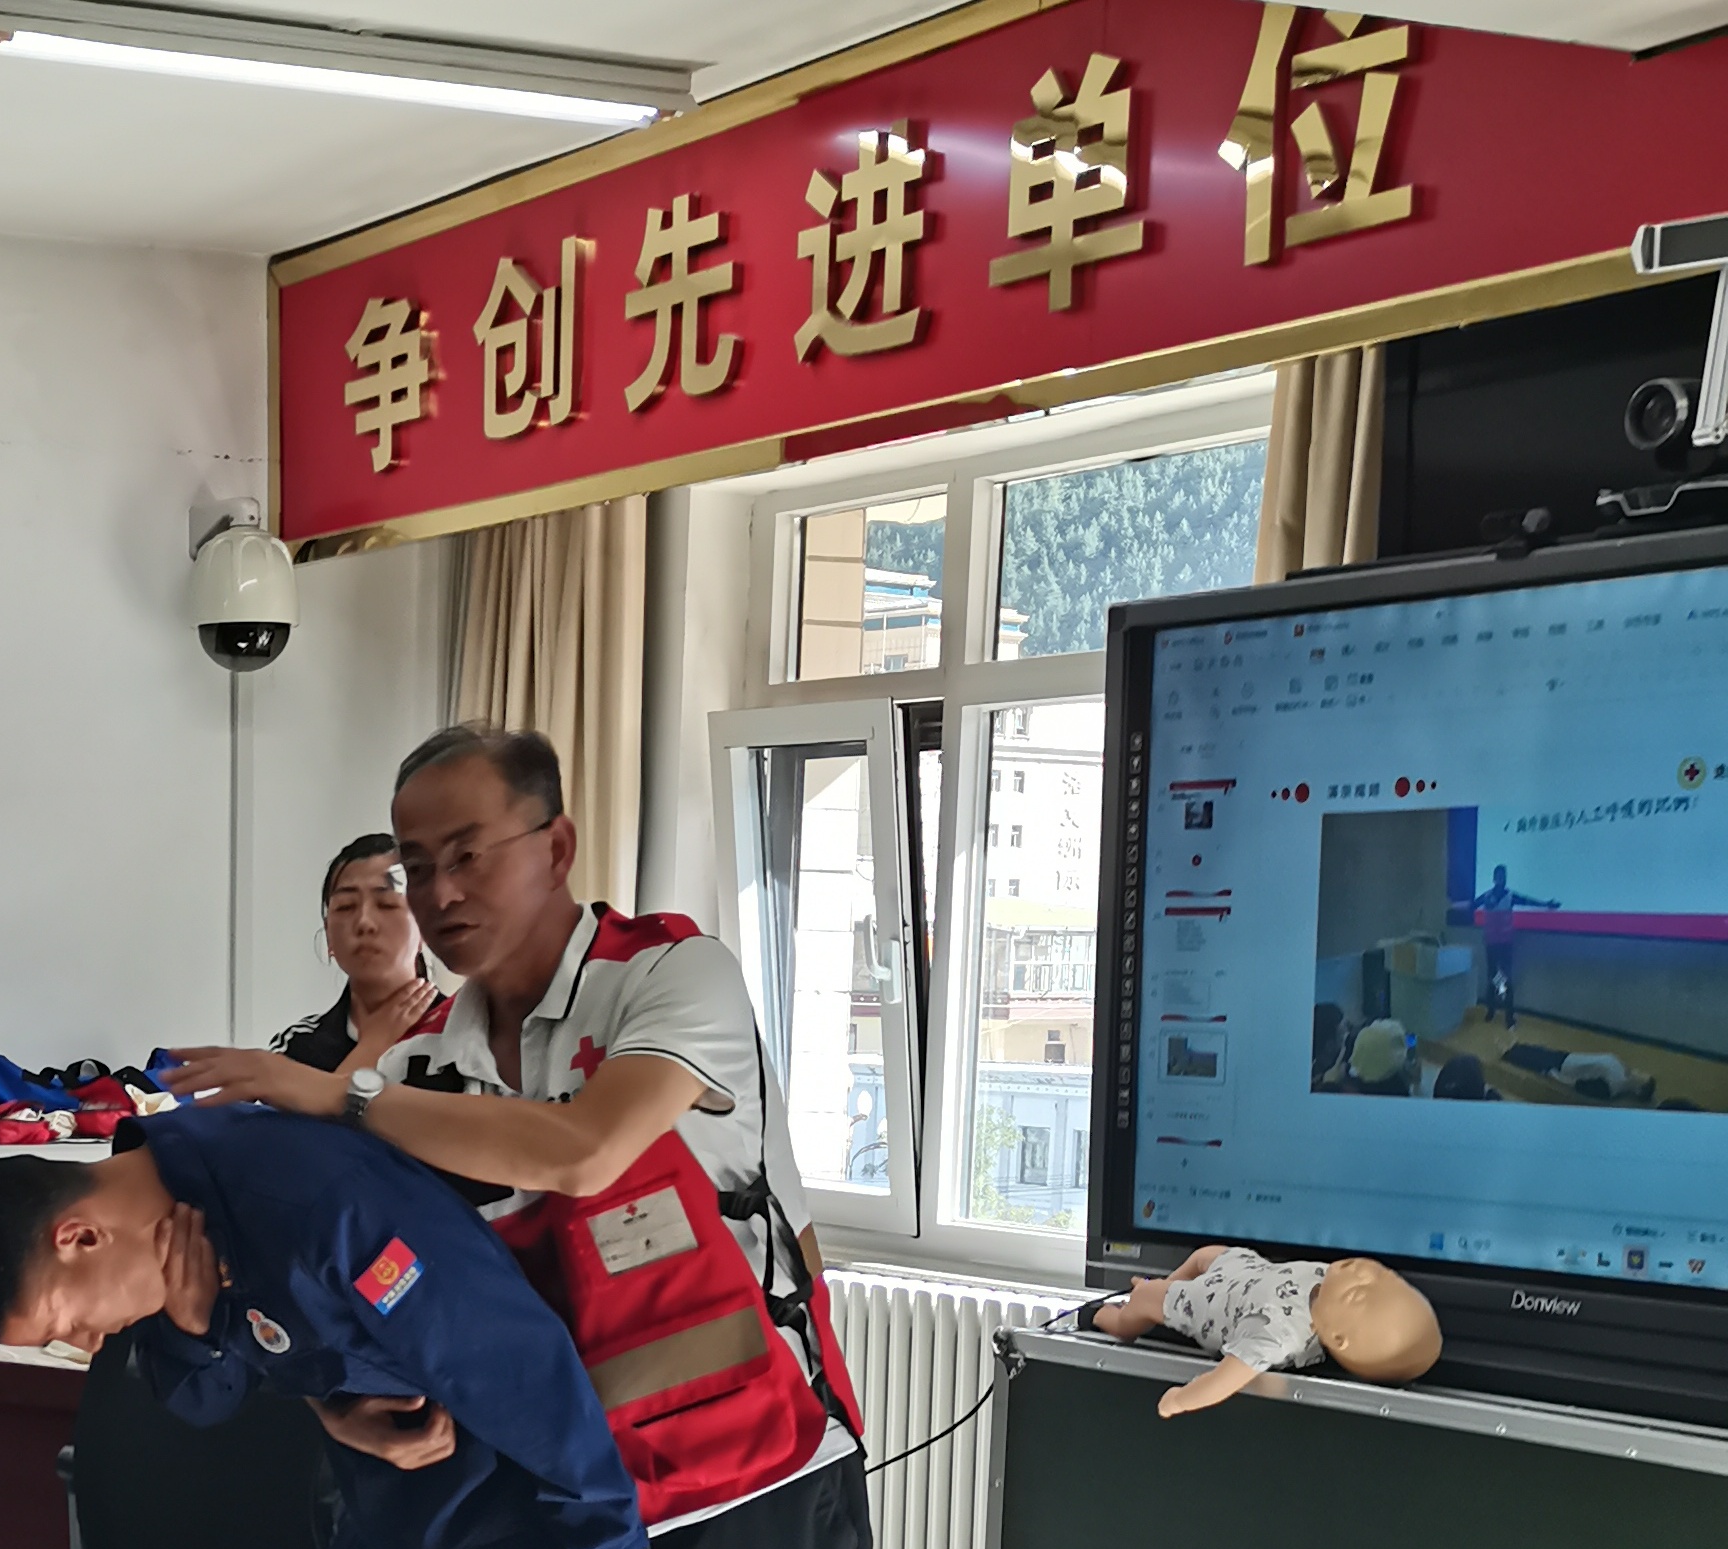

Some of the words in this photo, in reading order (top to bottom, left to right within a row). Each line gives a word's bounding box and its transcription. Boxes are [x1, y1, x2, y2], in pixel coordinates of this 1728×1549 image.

[342, 3, 1414, 473] 争创先进单位
[1511, 1289, 1581, 1316] Donview
